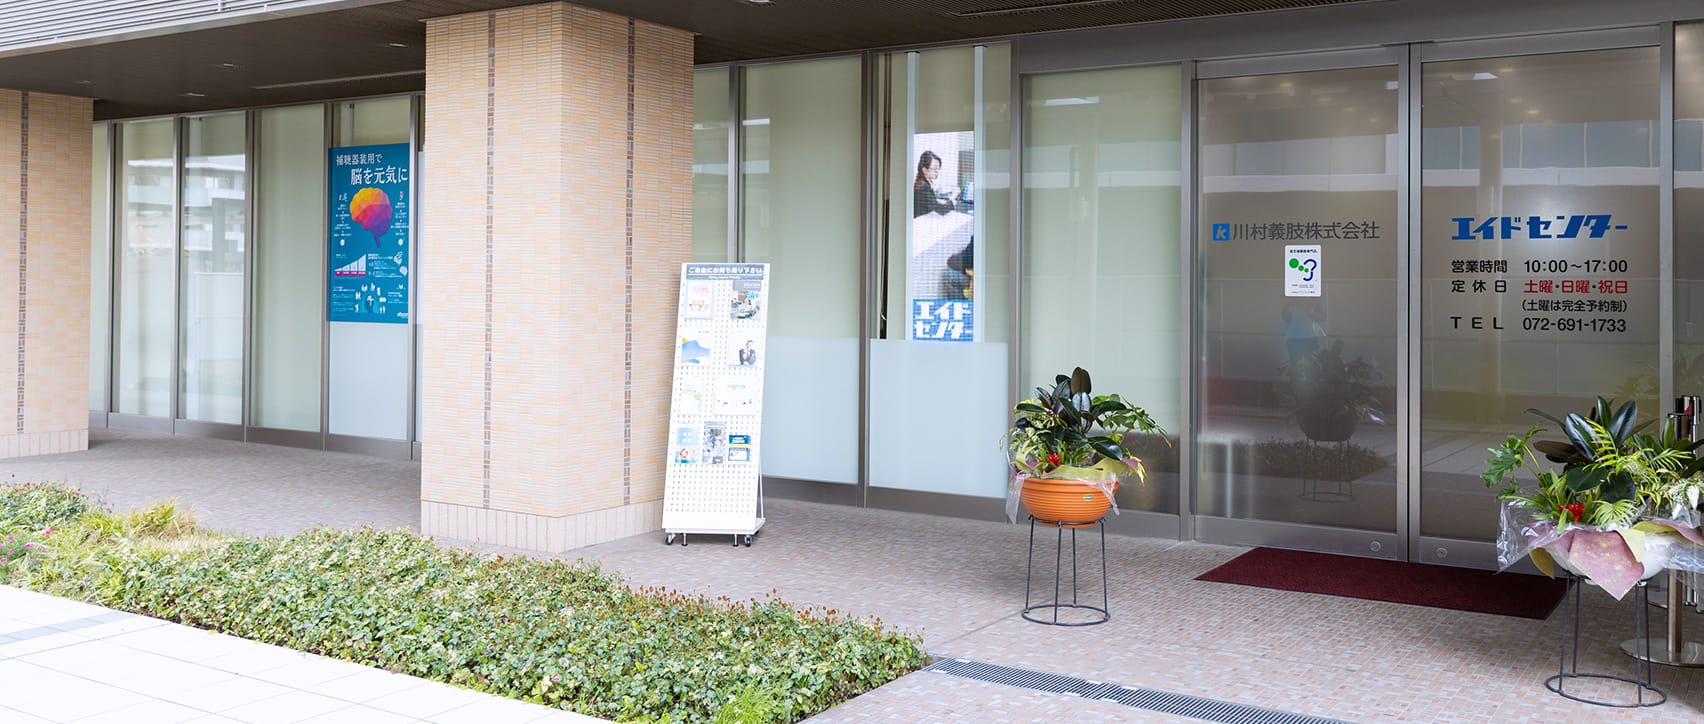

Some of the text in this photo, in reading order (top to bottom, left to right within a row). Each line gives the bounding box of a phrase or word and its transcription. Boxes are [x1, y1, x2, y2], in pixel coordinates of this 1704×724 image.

[336, 153, 383, 166] 補聴器装用で
[350, 165, 408, 185] 脳を元気に
[1233, 221, 1380, 240] 川村義肢株式会社
[1451, 214, 1628, 240] エイドセンター
[1451, 260, 1508, 273] 営業時間
[915, 301, 971, 319] エイド
[914, 320, 972, 339] センター
[1522, 317, 1627, 332] 072-691-1733
